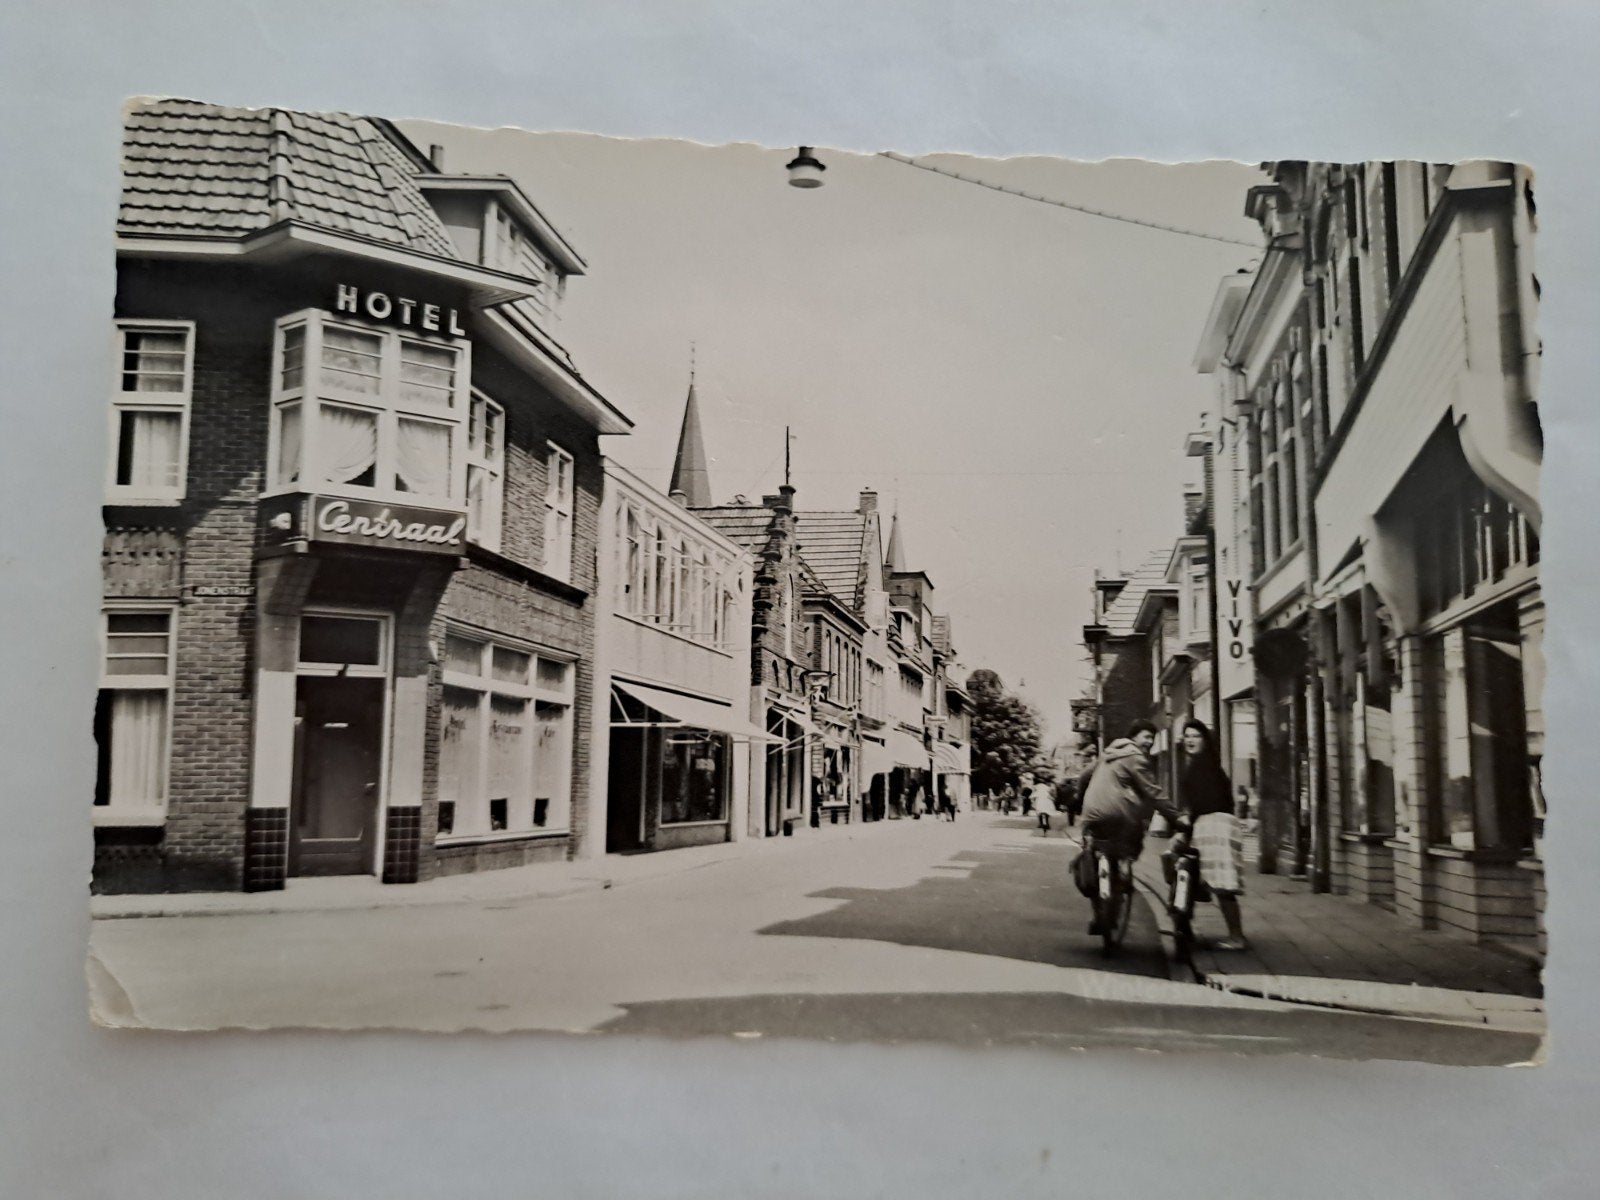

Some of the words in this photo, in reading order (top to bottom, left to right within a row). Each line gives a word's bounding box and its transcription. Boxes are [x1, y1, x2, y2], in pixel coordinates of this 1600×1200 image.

[337, 283, 466, 337] HOTEL
[318, 500, 465, 546] Centraal
[1226, 579, 1243, 659] VIVO
